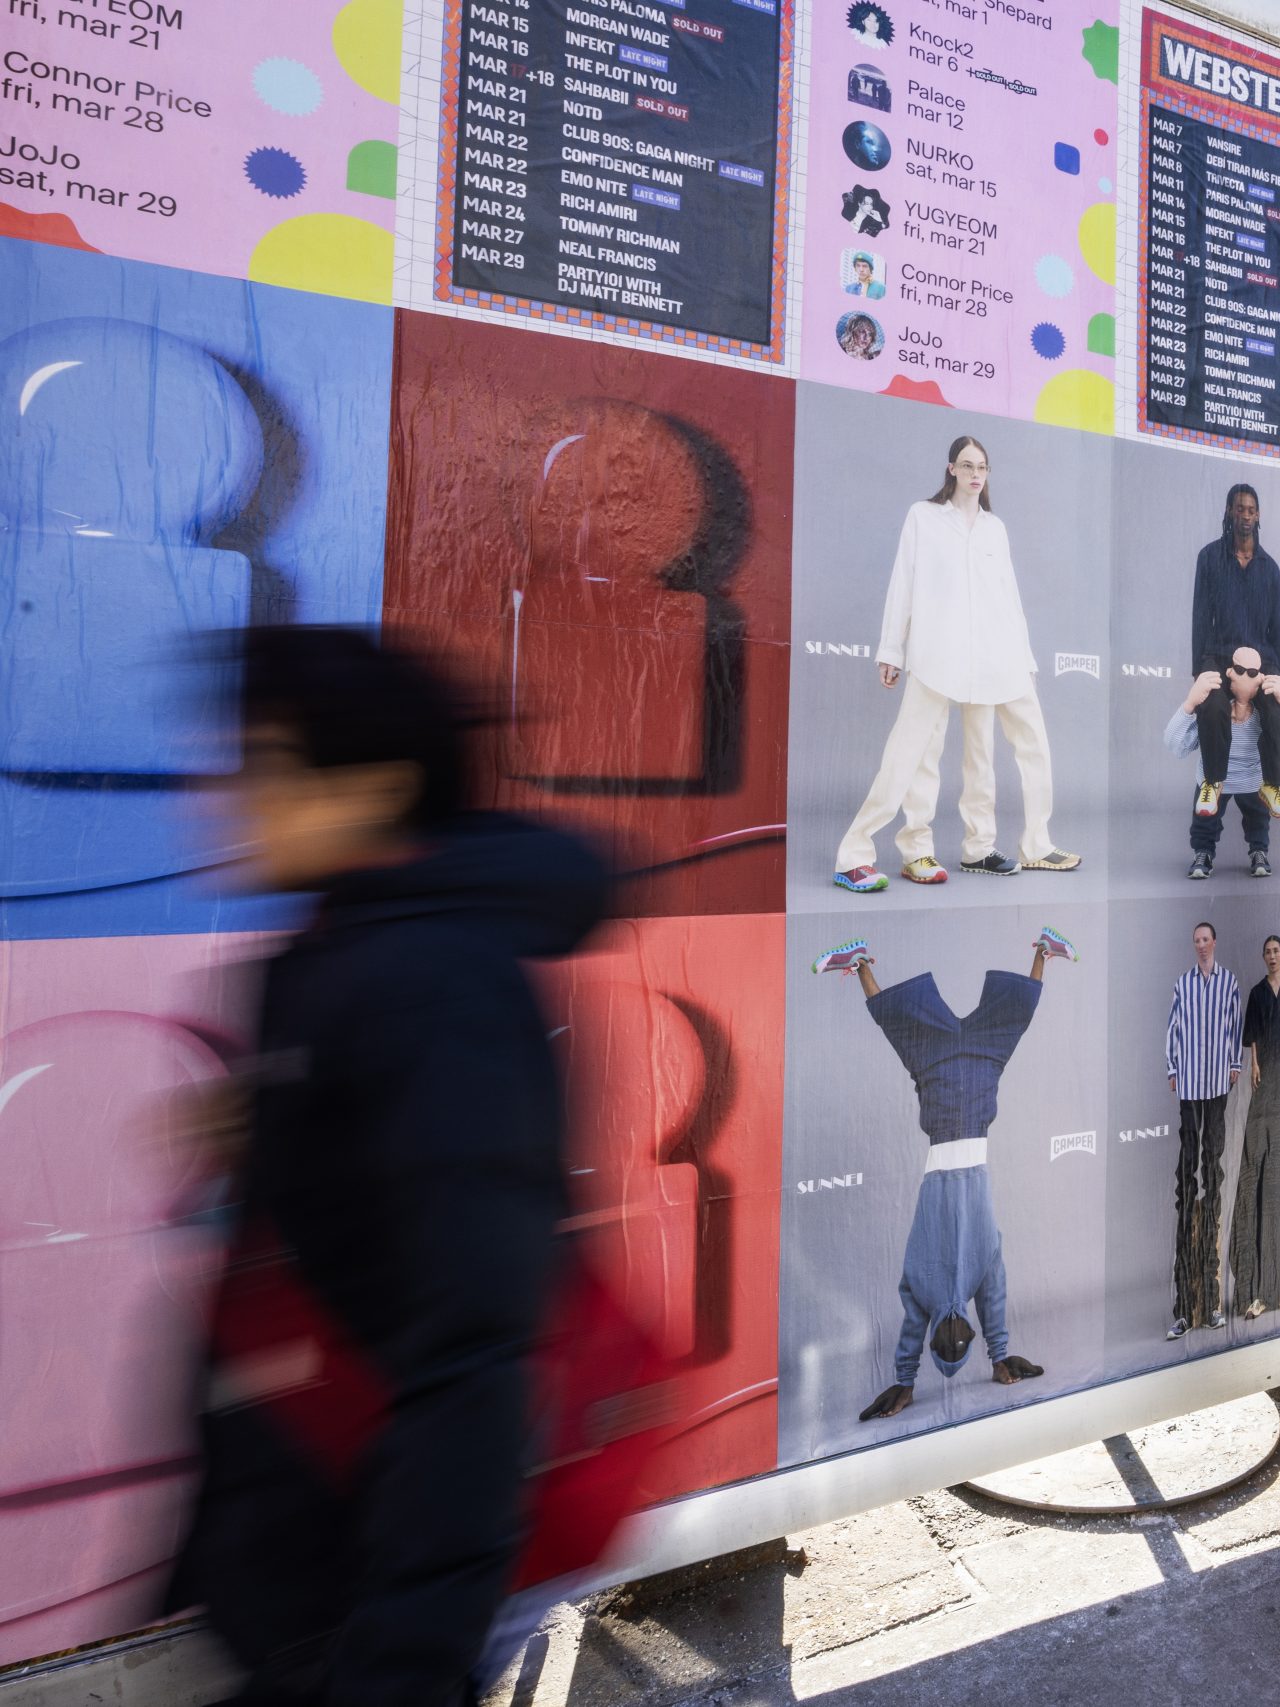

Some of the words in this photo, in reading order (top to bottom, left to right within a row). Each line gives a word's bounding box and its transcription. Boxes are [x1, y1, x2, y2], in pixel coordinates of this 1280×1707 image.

[470, 4, 508, 28] MAR
[512, 16, 529, 33] 15
[610, 0, 667, 25] PALOMA
[945, 0, 978, 20] mar
[982, 11, 988, 25] 1
[58, 9, 121, 39] mar
[129, 24, 160, 50] 21
[566, 8, 628, 36] MORGAN
[630, 26, 670, 49] WADE
[673, 17, 700, 33] SOLD
[703, 26, 723, 39] OUT
[910, 22, 974, 59] Knock2
[469, 28, 508, 52] MAR
[511, 40, 529, 57] 16
[565, 30, 615, 55] INFEKT
[468, 52, 507, 76] MAR
[909, 45, 943, 66] mar
[948, 56, 958, 72] 6
[3, 50, 126, 97] Connor
[135, 80, 212, 118] Price
[565, 54, 592, 73] THE
[595, 61, 631, 83] PLOT
[633, 72, 647, 87] IN
[650, 75, 677, 95] YOU
[468, 76, 506, 99] MAR
[509, 86, 526, 104] 21
[564, 77, 629, 105] SAHBABII
[908, 80, 965, 112] Palace
[1, 78, 41, 109] fri,
[52, 92, 115, 122] mar
[123, 106, 164, 133] 28
[467, 100, 506, 123] MAR
[508, 110, 526, 127] 21
[563, 100, 603, 121] NOTD
[637, 98, 664, 113] SOLD
[668, 106, 688, 119] OUT
[907, 100, 942, 125] mar
[947, 113, 964, 130] 12
[466, 123, 504, 146] MAR
[507, 134, 528, 151] 22
[562, 123, 600, 144] CLUB
[636, 141, 673, 163] GAGA
[674, 151, 715, 172] NIGHT
[1207, 135, 1242, 156] VANSIRE
[0, 136, 81, 170] JoJo
[465, 147, 504, 170] MAR
[506, 158, 528, 175] 22
[907, 138, 974, 171] NURKO
[562, 147, 650, 179] CONFIDENCE
[652, 168, 683, 188] MAN
[905, 161, 937, 183] sat,
[942, 170, 976, 190] mar
[979, 180, 997, 198] 15
[1227, 160, 1250, 177] TIRAR
[0, 167, 55, 197] sat,
[66, 181, 129, 209] mar
[136, 191, 177, 218] 29
[464, 172, 503, 194] MAR
[506, 181, 527, 199] 23
[561, 169, 593, 189] EMO
[595, 178, 628, 197] NITE
[1206, 171, 1245, 193] TRIVECTA
[463, 196, 502, 218] MAR
[505, 204, 526, 222] 24
[560, 193, 594, 213] RICH
[597, 202, 638, 221] AMIRI
[1206, 189, 1229, 206] PARIS
[1230, 196, 1264, 215] PALOMA
[462, 220, 501, 241] MAR
[504, 228, 524, 245] 27
[904, 200, 998, 240] YUGYEOM
[1206, 207, 1242, 227] MORGAN
[1242, 217, 1266, 234] WADE
[1206, 224, 1234, 241] INFEKT
[559, 216, 614, 239] TOMMY
[617, 229, 680, 254] RICHMAN
[903, 221, 925, 244] fri,
[930, 229, 964, 251] mar
[968, 238, 986, 256] 21
[461, 243, 501, 265] MAR
[503, 252, 525, 269] 29
[559, 240, 595, 260] NEAL
[598, 248, 657, 272] FRANCIS
[1205, 259, 1242, 278] SAHBABII
[558, 278, 577, 293] DJ
[580, 284, 619, 303] MATT
[621, 291, 683, 314] BENNETT
[626, 276, 662, 296] WITH
[901, 263, 967, 293] Connor
[971, 280, 1014, 304] Price
[1205, 277, 1228, 291] NOTD
[900, 283, 921, 305] fri,
[927, 292, 961, 311] mar
[965, 299, 987, 317] 28
[898, 326, 943, 349] JoJo
[1205, 313, 1256, 334] CONFIDENCE
[1257, 323, 1275, 338] MAN
[898, 348, 929, 369] sat,
[935, 353, 968, 373] mar
[973, 361, 995, 379] 29
[1205, 347, 1225, 361] RICH
[1226, 354, 1249, 367] AMIRI
[1205, 365, 1236, 381] TOMMY
[1237, 374, 1275, 390] RICHMAN
[1205, 383, 1226, 397] NEAL
[1227, 389, 1261, 404] FRANCIS
[1205, 414, 1216, 424] DJ
[1217, 415, 1240, 429] MATT
[1242, 420, 1278, 435] BENNETT
[1244, 409, 1264, 421] WITH
[1057, 655, 1098, 674] CAMPER
[1053, 1133, 1094, 1156] CAMPER
